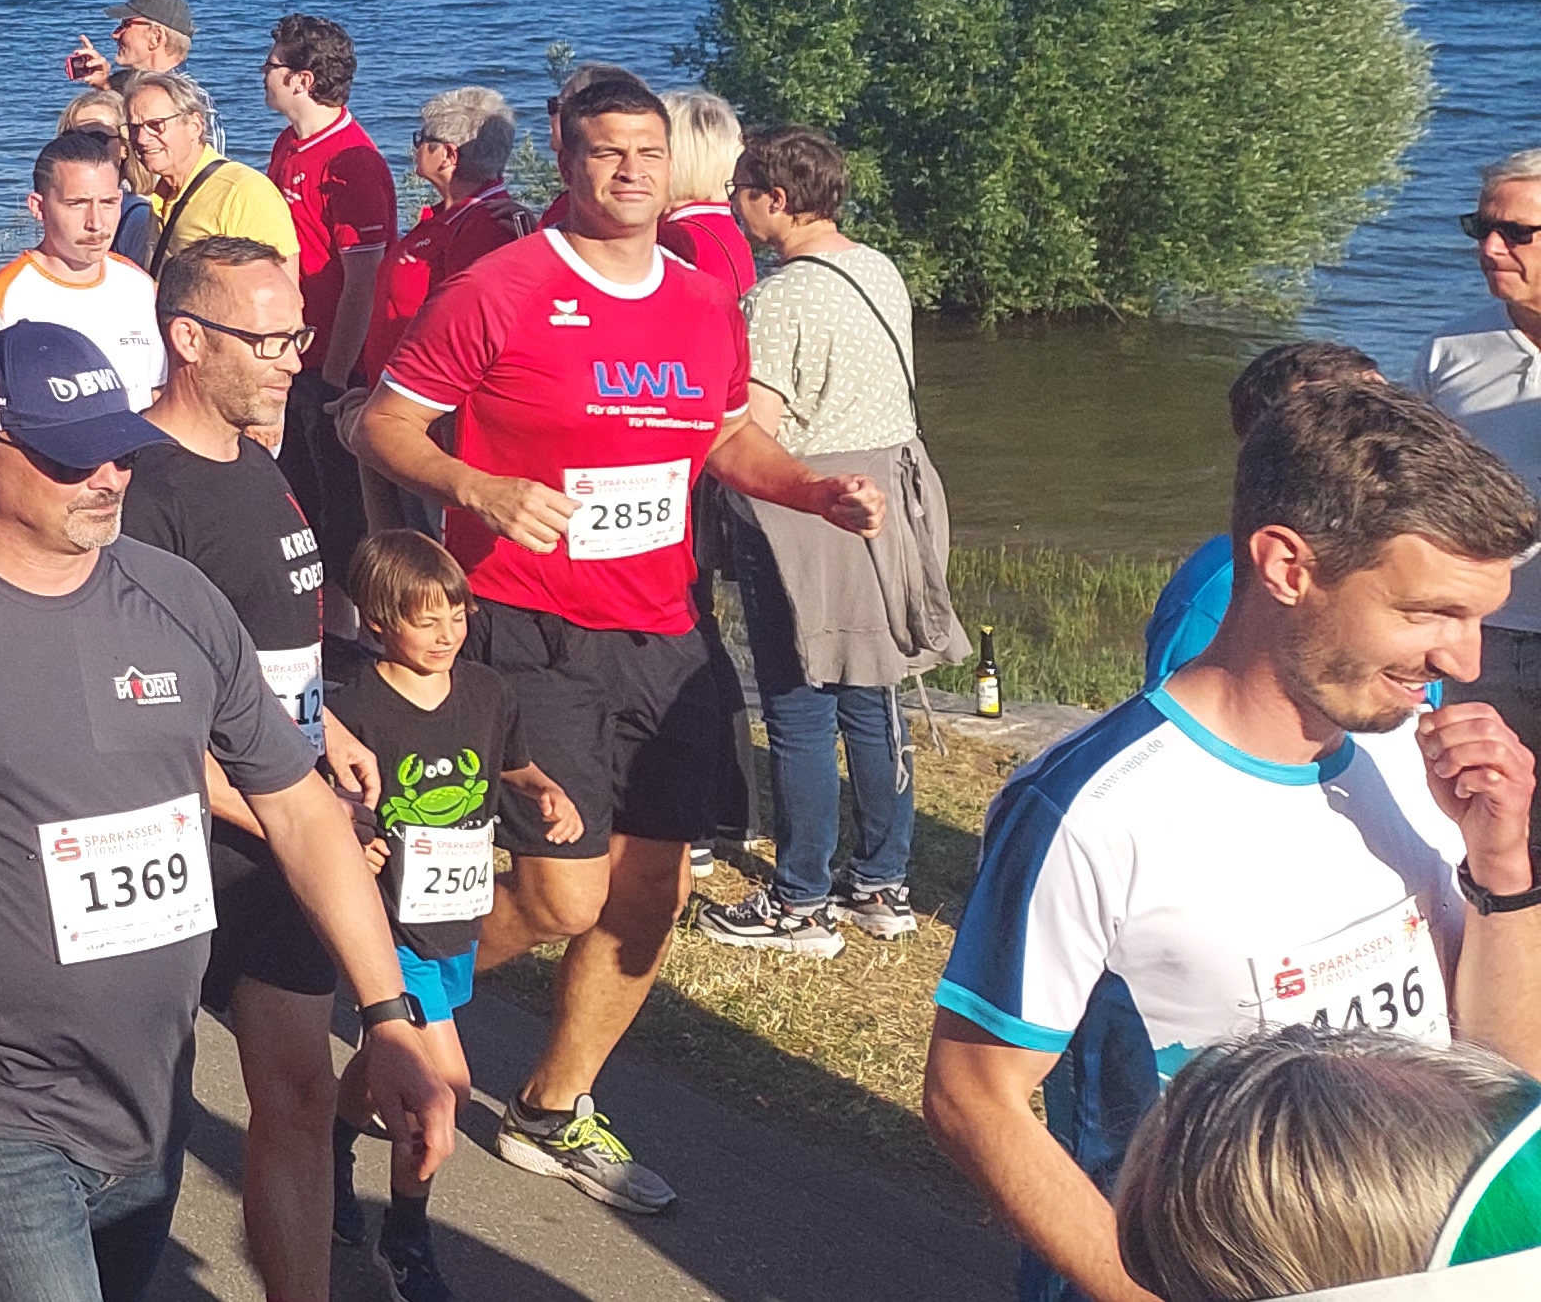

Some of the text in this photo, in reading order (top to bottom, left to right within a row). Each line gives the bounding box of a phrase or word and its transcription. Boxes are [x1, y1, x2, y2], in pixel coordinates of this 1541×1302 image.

[593, 361, 704, 398] LWL
[598, 477, 657, 487] SPARKASSEN
[590, 498, 671, 530] 2858
[114, 677, 177, 700] FAVORIT
[1089, 739, 1164, 800] www.wepa.de
[84, 823, 162, 848] SPARKASSEN
[80, 853, 188, 913] 1369
[423, 861, 488, 894] 2504
[1309, 934, 1393, 977] SPARKASSEN
[1312, 951, 1394, 990] FIRMENLAUF
